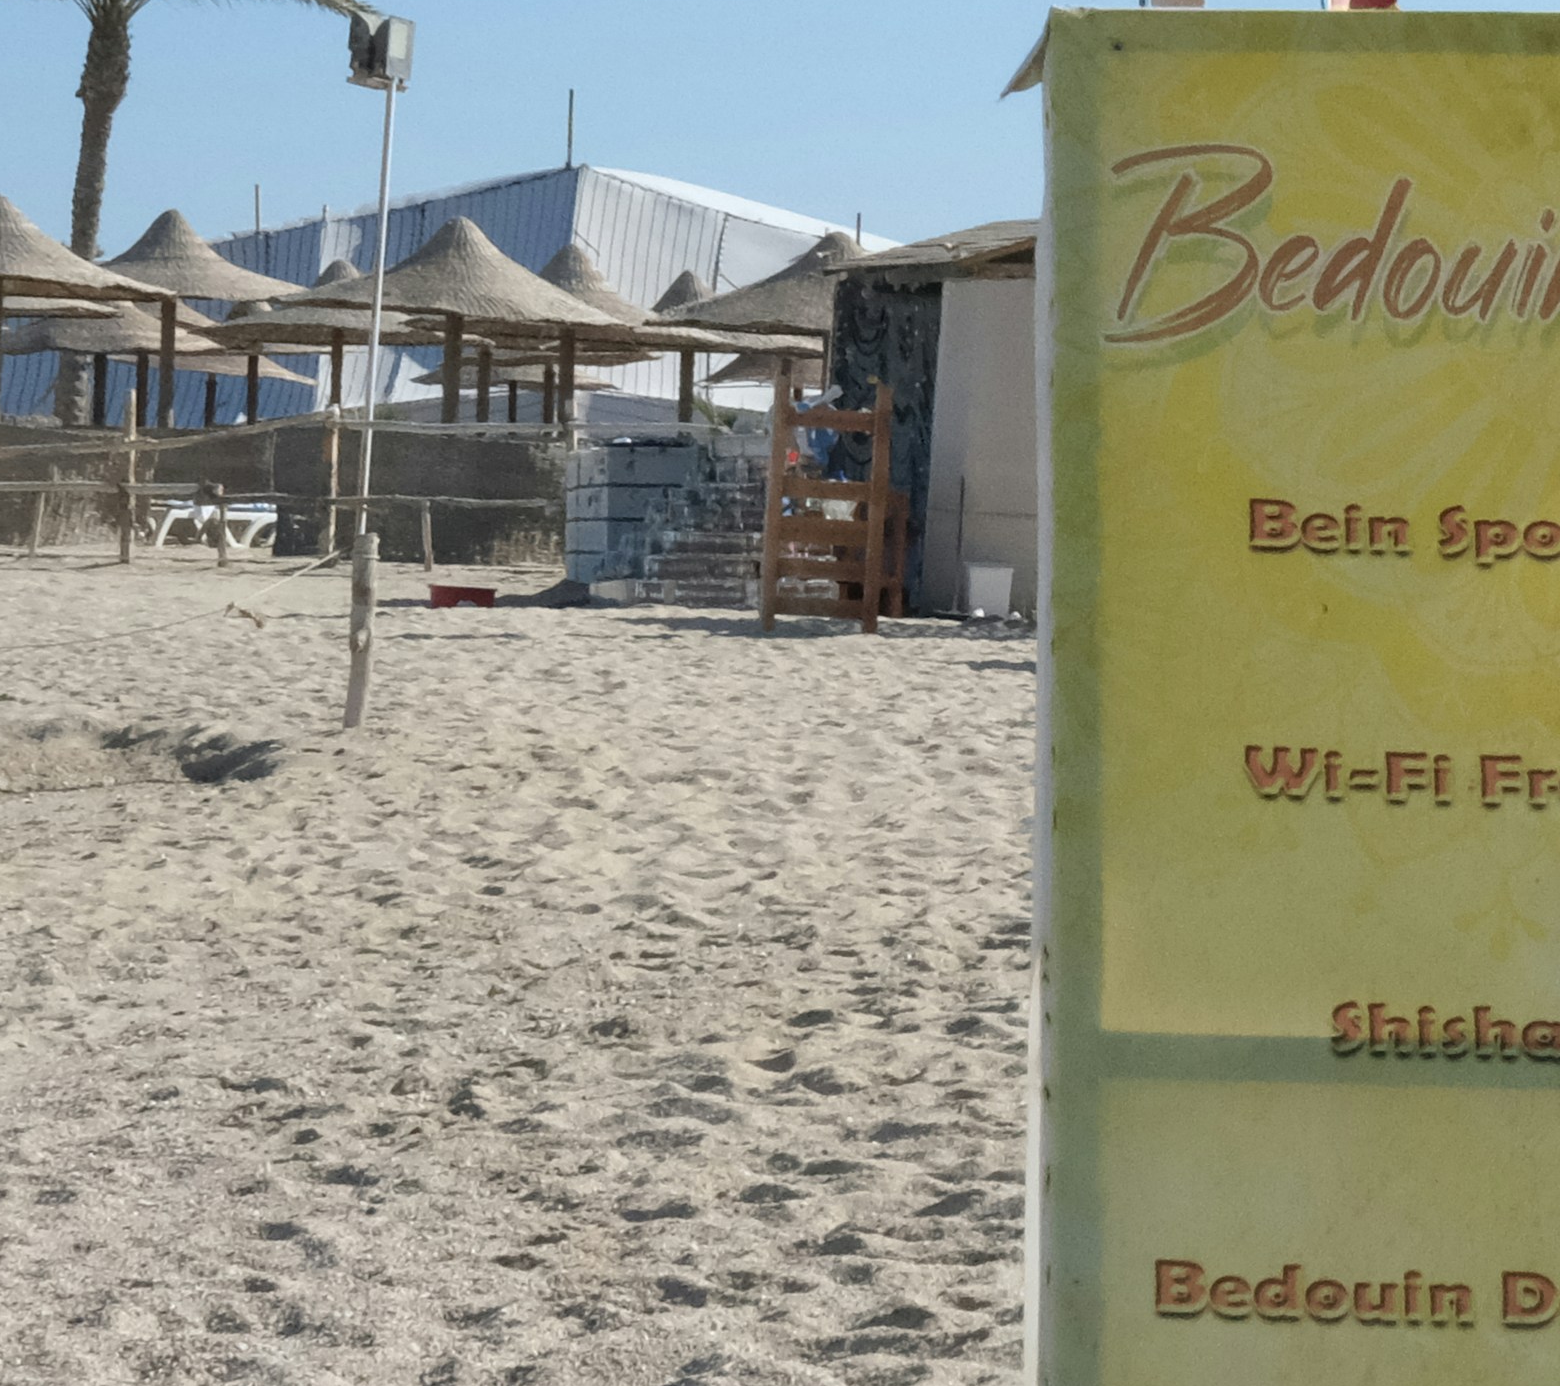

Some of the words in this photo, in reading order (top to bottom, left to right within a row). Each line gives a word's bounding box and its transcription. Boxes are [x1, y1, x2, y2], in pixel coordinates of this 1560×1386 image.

[1247, 496, 1412, 556] Bein
[1244, 744, 1453, 806] Wi-Fi
[1153, 1259, 1475, 1328] Bedouin
